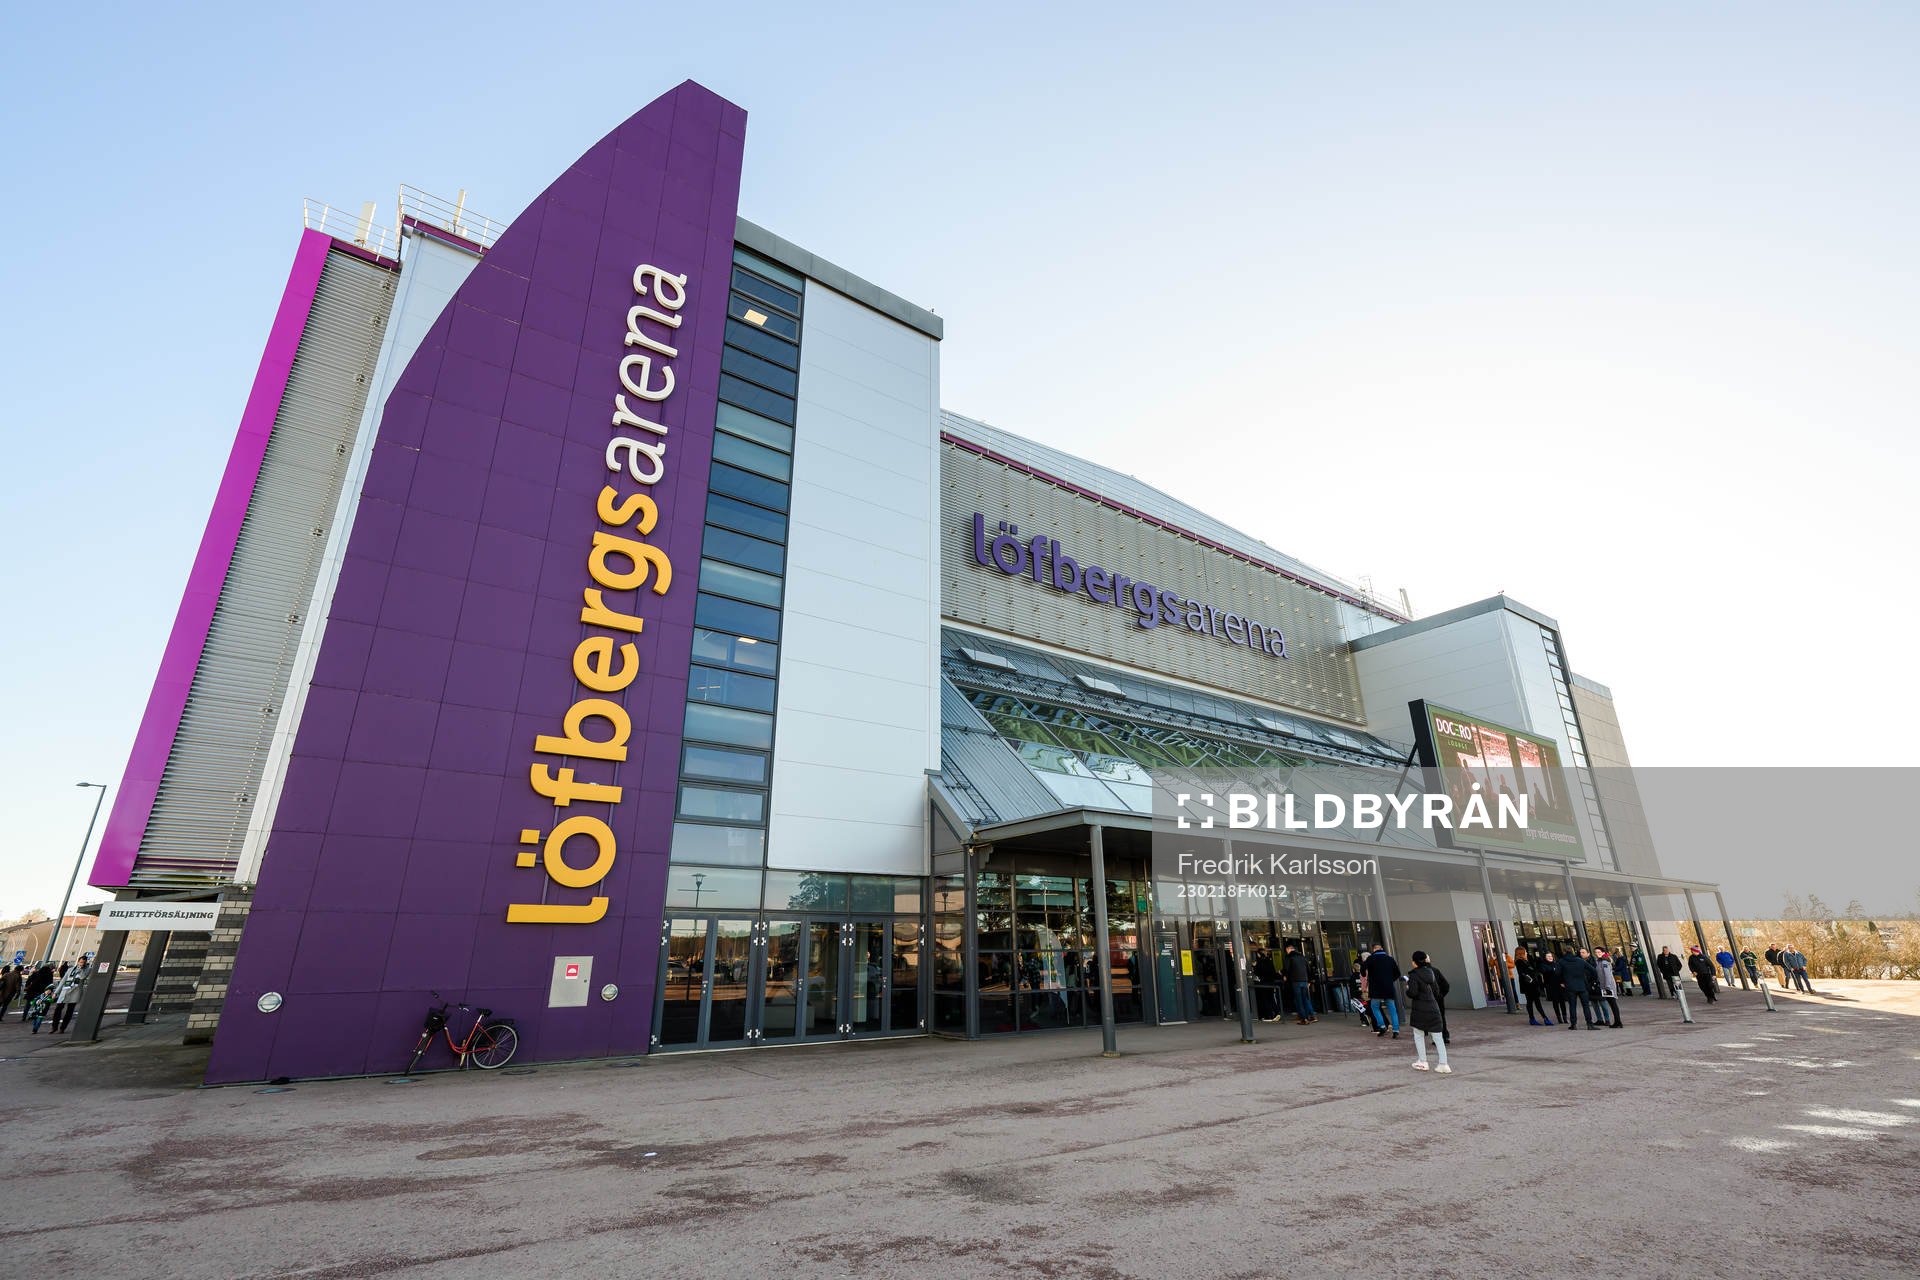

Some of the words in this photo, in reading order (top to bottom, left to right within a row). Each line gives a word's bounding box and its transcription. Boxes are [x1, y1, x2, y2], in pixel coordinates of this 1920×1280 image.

[506, 264, 687, 924] löfbergsarena
[973, 512, 1289, 659] löfbergsarena
[109, 909, 214, 919] BILJETTFÖRSÄLJNING
